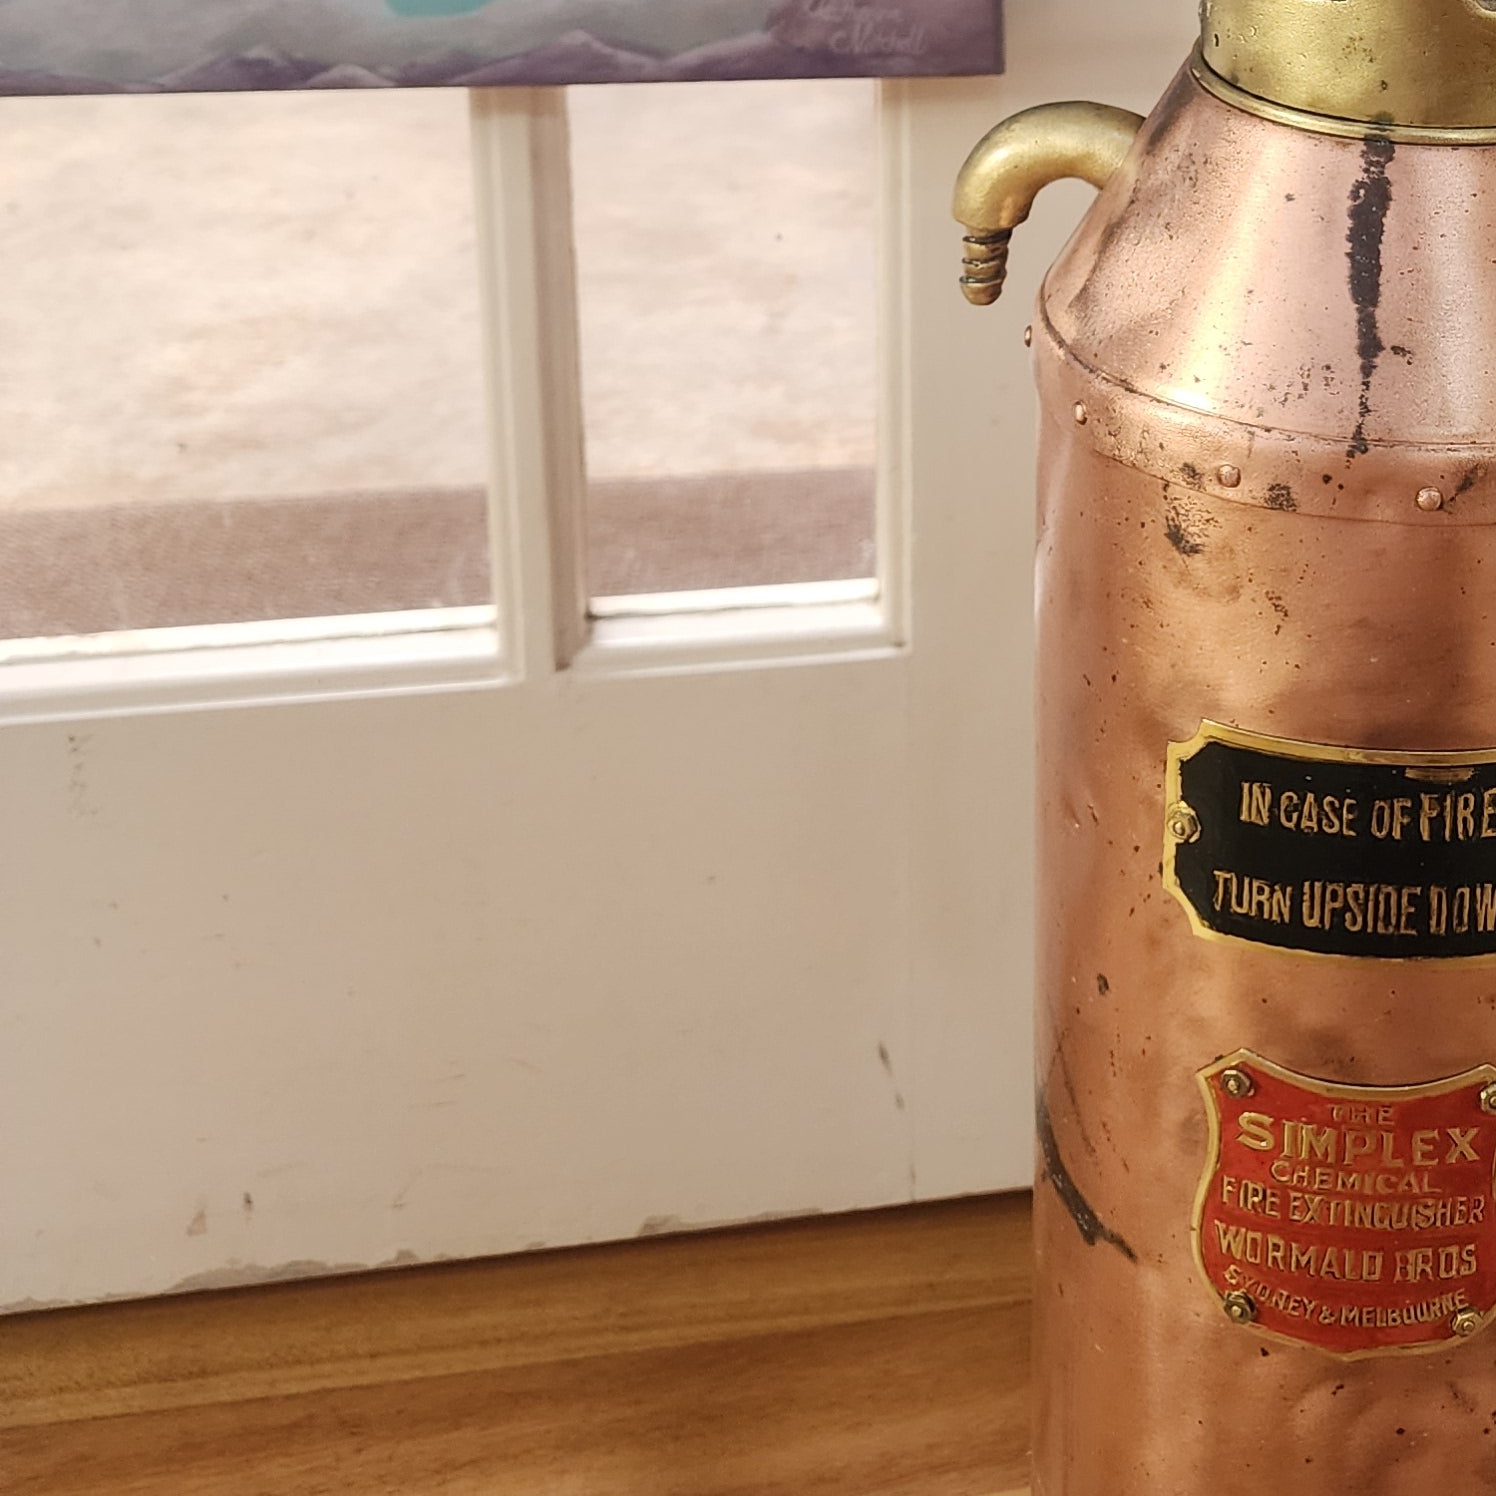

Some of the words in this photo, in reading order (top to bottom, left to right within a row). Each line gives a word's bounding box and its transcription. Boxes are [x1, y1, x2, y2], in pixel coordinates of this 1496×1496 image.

[1240, 781, 1272, 826] IN
[1279, 790, 1357, 837] CASE
[1371, 797, 1411, 840] OF
[1212, 869, 1294, 925] TURN
[1301, 880, 1421, 936] UPSIDE
[1236, 1110, 1481, 1167] SIMPLEX
[1329, 1104, 1396, 1126] THE
[1222, 1175, 1281, 1218] FIRE
[1288, 1189, 1486, 1232] EXTINGUISHER
[1270, 1159, 1442, 1195] CHEMICAL
[1214, 1218, 1383, 1282] WORMALD
[1394, 1243, 1478, 1283] BROS
[1222, 1264, 1317, 1320] SYDNEY
[1318, 1303, 1336, 1325] &
[1339, 1287, 1469, 1328] MELBOURNE
